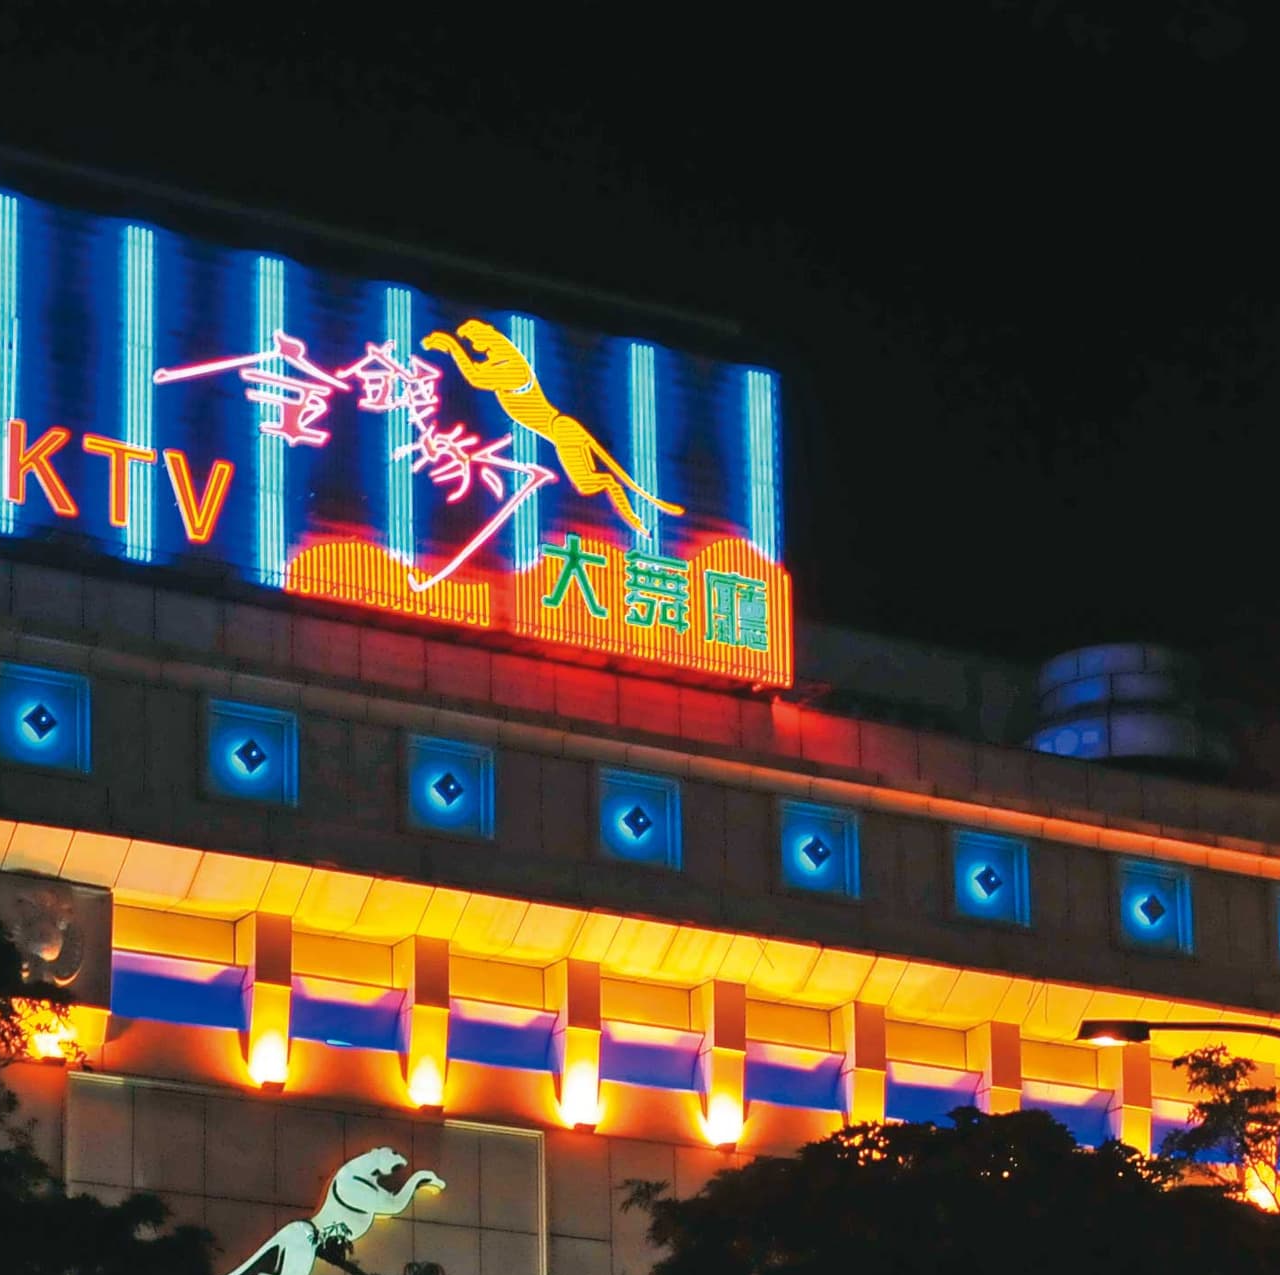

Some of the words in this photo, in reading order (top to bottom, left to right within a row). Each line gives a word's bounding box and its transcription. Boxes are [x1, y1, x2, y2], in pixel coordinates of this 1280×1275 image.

[6, 418, 236, 545] KTV
[540, 532, 770, 652] 大舞廳
